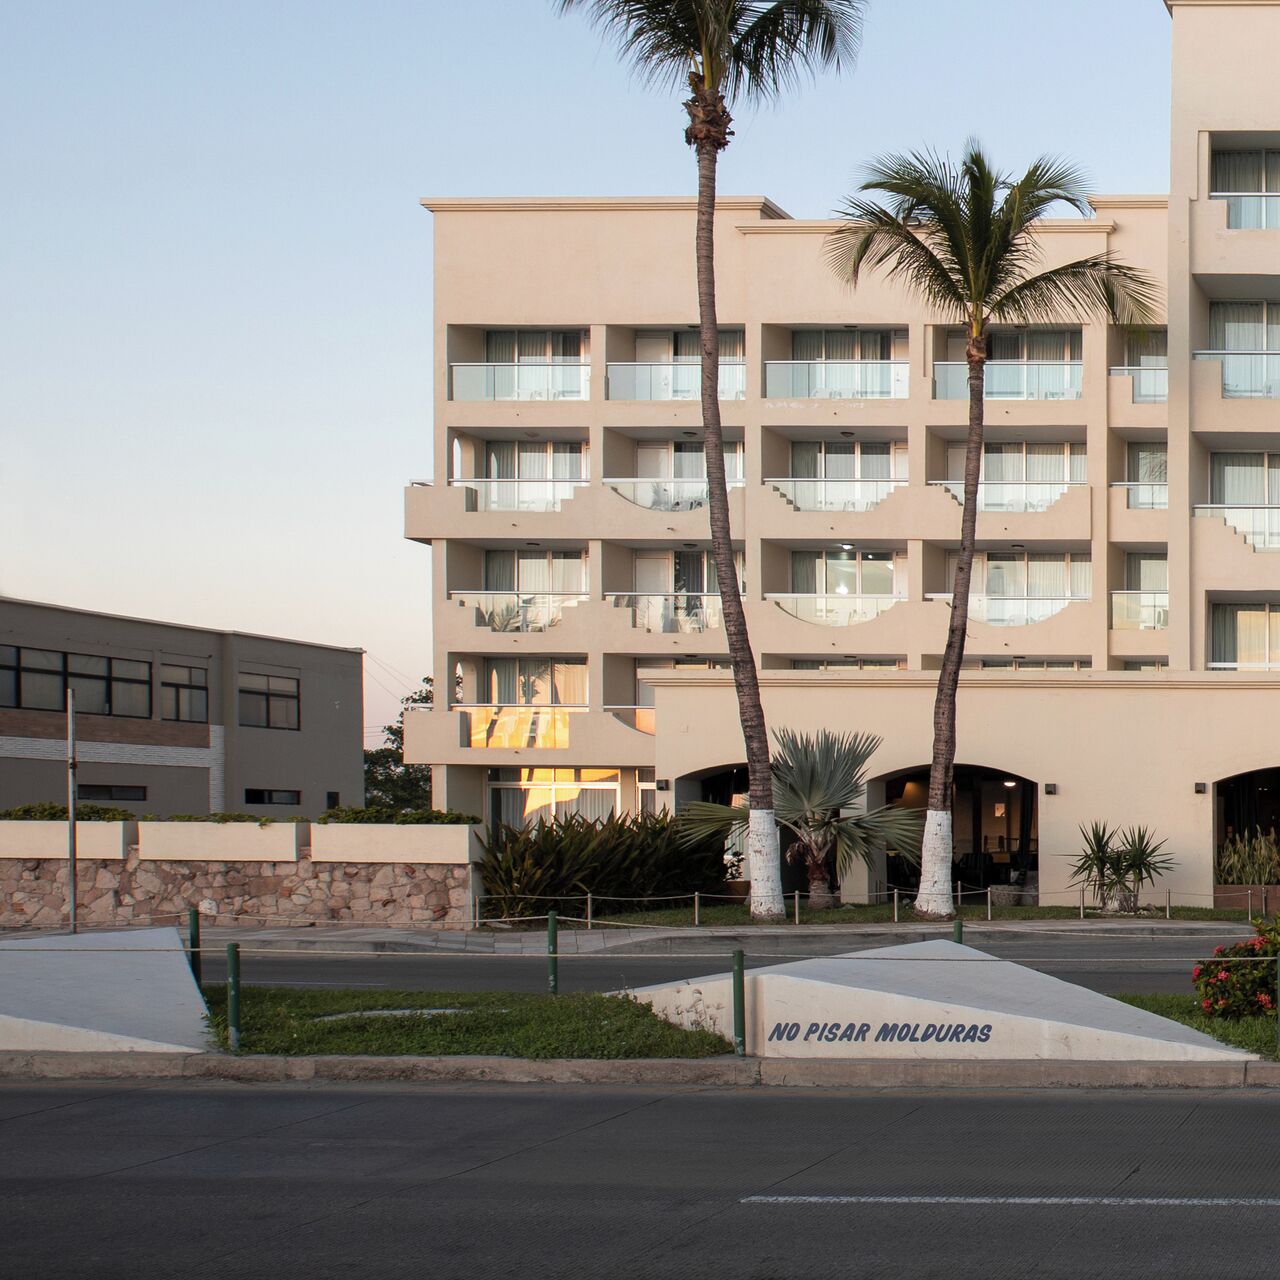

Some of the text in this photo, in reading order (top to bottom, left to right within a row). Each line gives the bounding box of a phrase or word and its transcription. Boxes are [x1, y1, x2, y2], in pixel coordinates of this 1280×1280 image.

[768, 1022, 993, 1043] NO PISAR MOLDURAS
